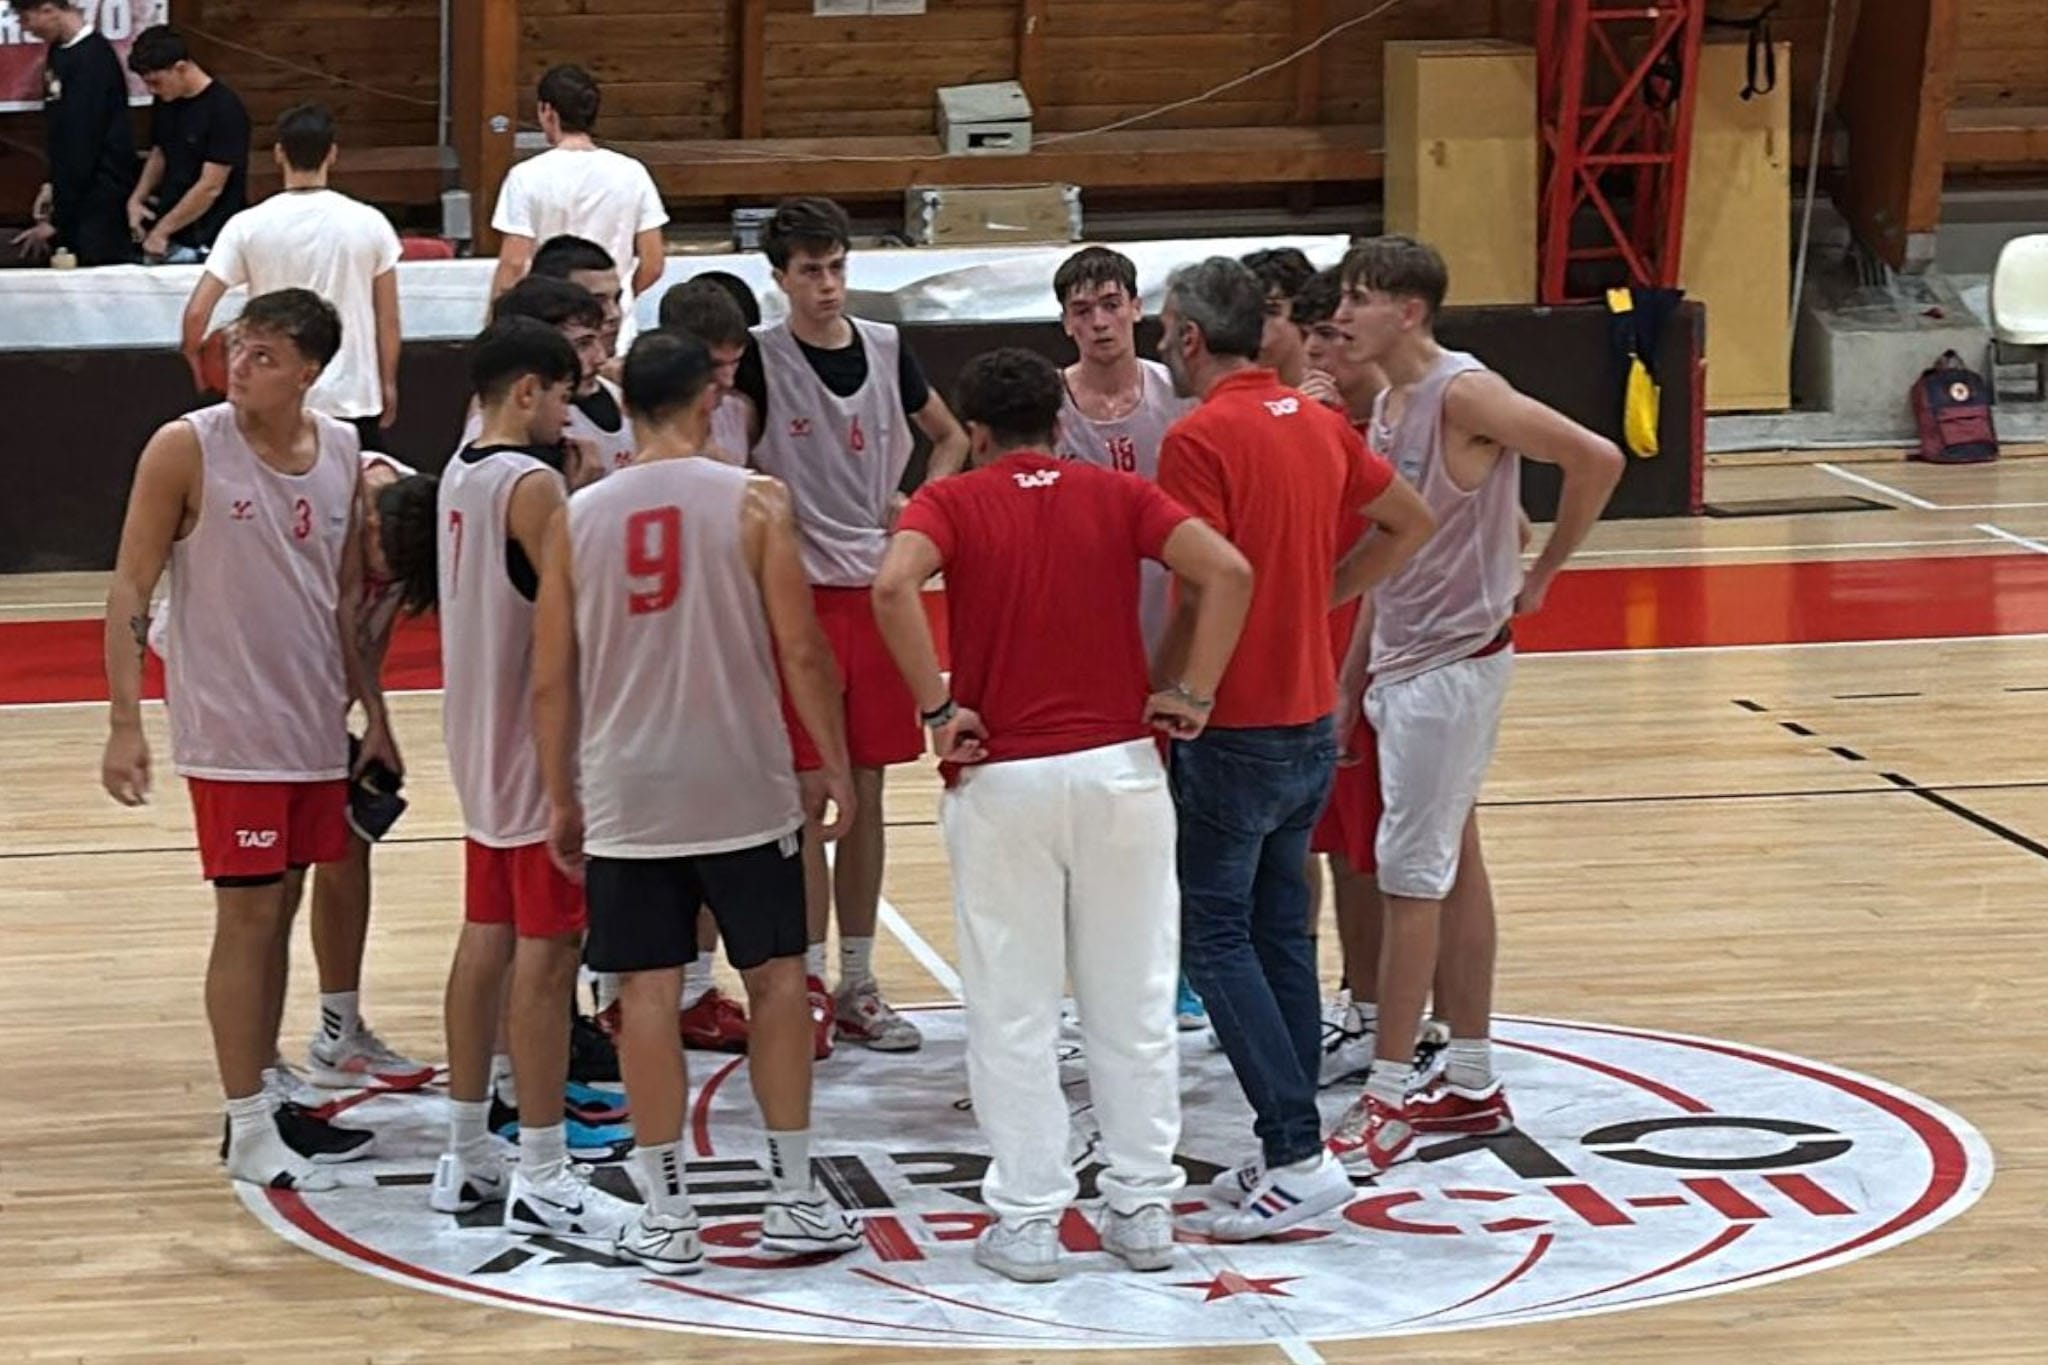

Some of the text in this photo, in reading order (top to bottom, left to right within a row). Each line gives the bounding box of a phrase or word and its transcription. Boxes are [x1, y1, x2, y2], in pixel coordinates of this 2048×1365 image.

[849, 415, 866, 452] 6
[1105, 436, 1136, 473] 18
[293, 497, 312, 541] 3
[448, 509, 465, 602] 7
[626, 504, 682, 616] 9
